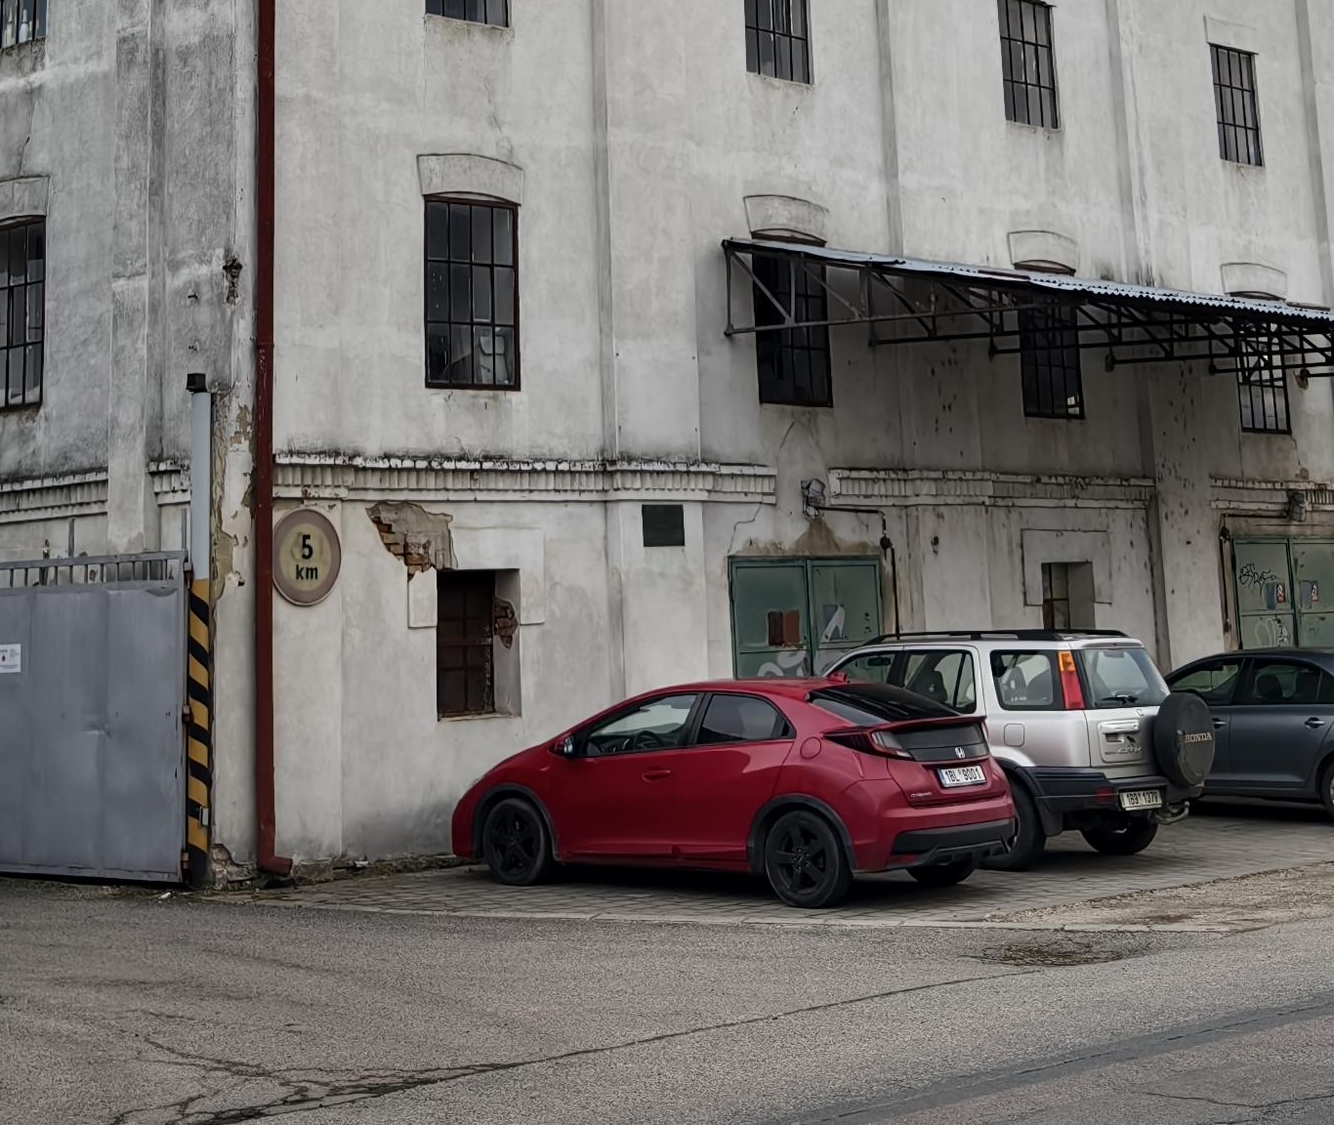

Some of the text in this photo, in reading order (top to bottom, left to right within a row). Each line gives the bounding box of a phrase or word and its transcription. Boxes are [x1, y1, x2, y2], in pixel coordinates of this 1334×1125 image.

[301, 534, 313, 560] 5
[295, 564, 318, 580] km
[1185, 732, 1212, 743] HONDA
[962, 767, 981, 780] 9001
